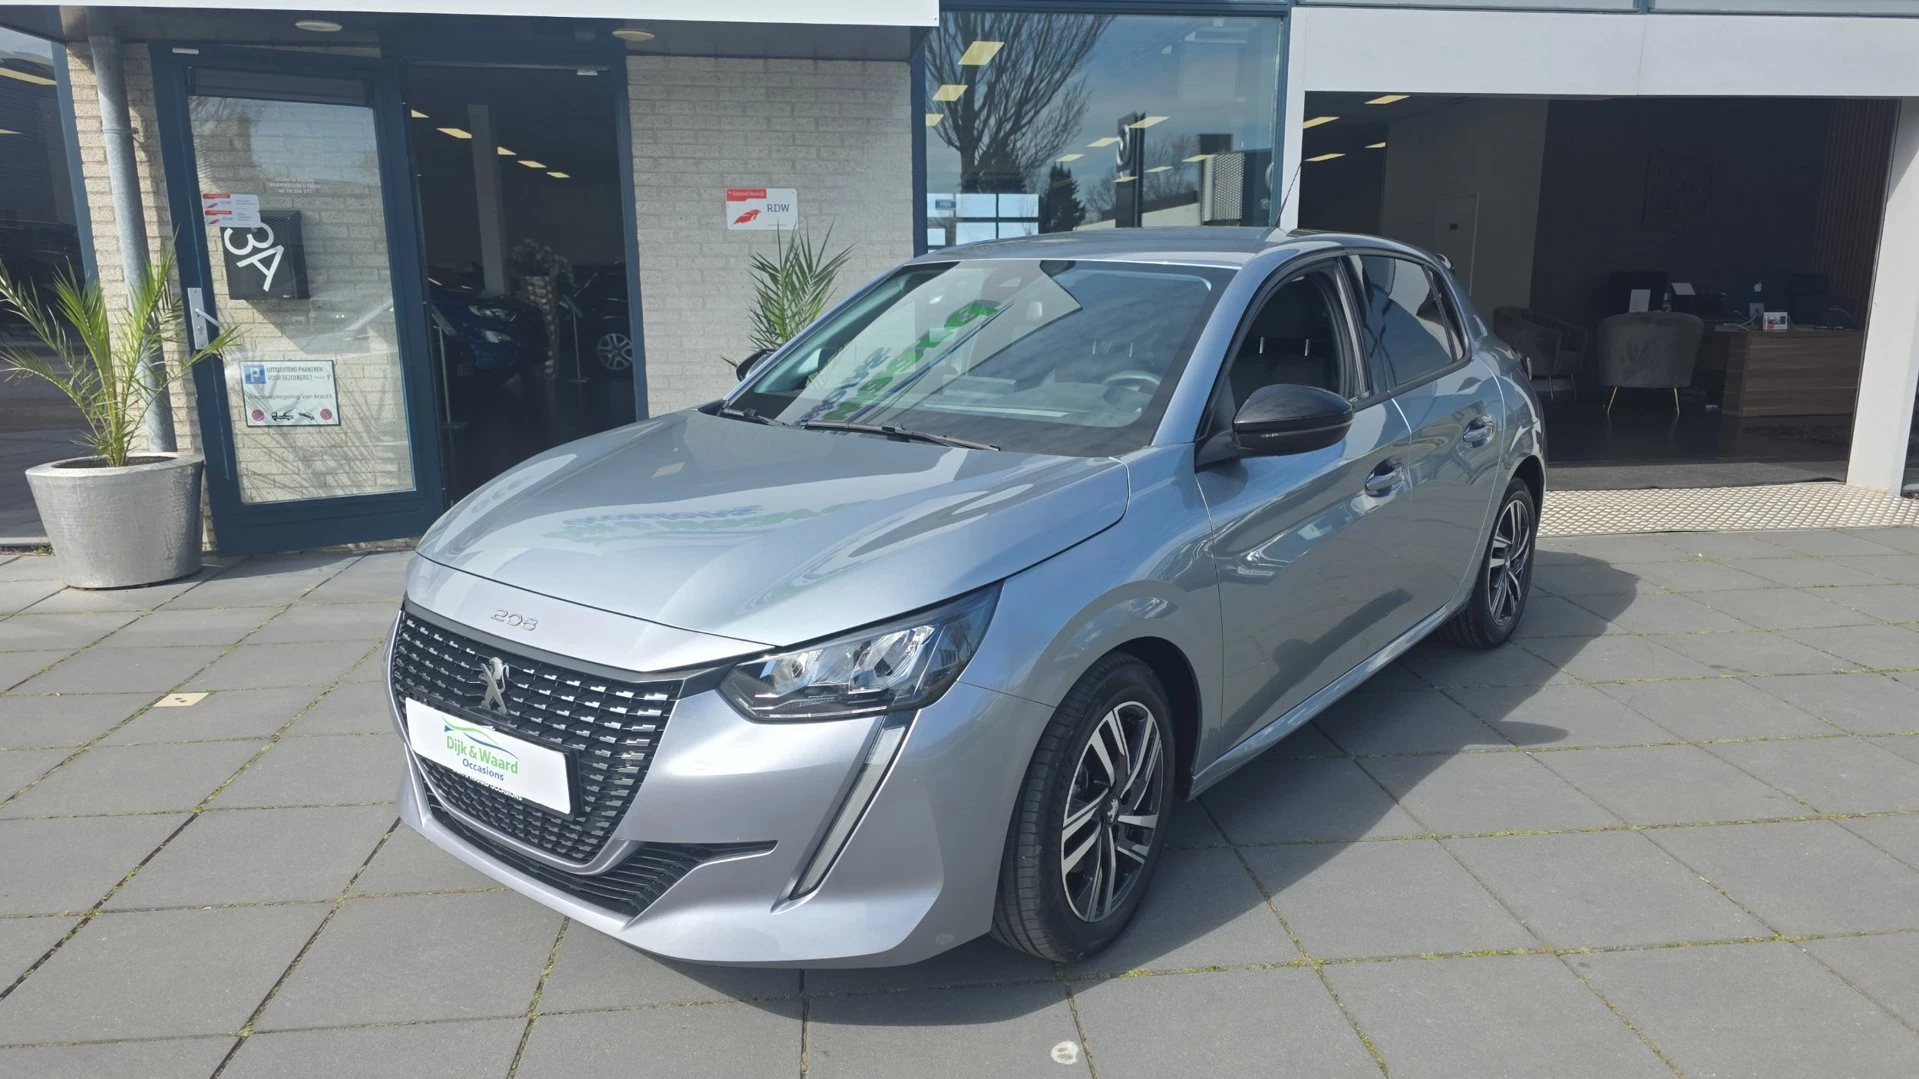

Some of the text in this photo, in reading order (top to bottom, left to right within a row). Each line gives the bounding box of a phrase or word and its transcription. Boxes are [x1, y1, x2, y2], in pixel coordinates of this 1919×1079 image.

[767, 204, 790, 213] RDW
[224, 222, 285, 292] 3A
[491, 607, 538, 632] 208
[446, 735, 519, 775] Dijk & Waard
[462, 758, 505, 782] Occasions
